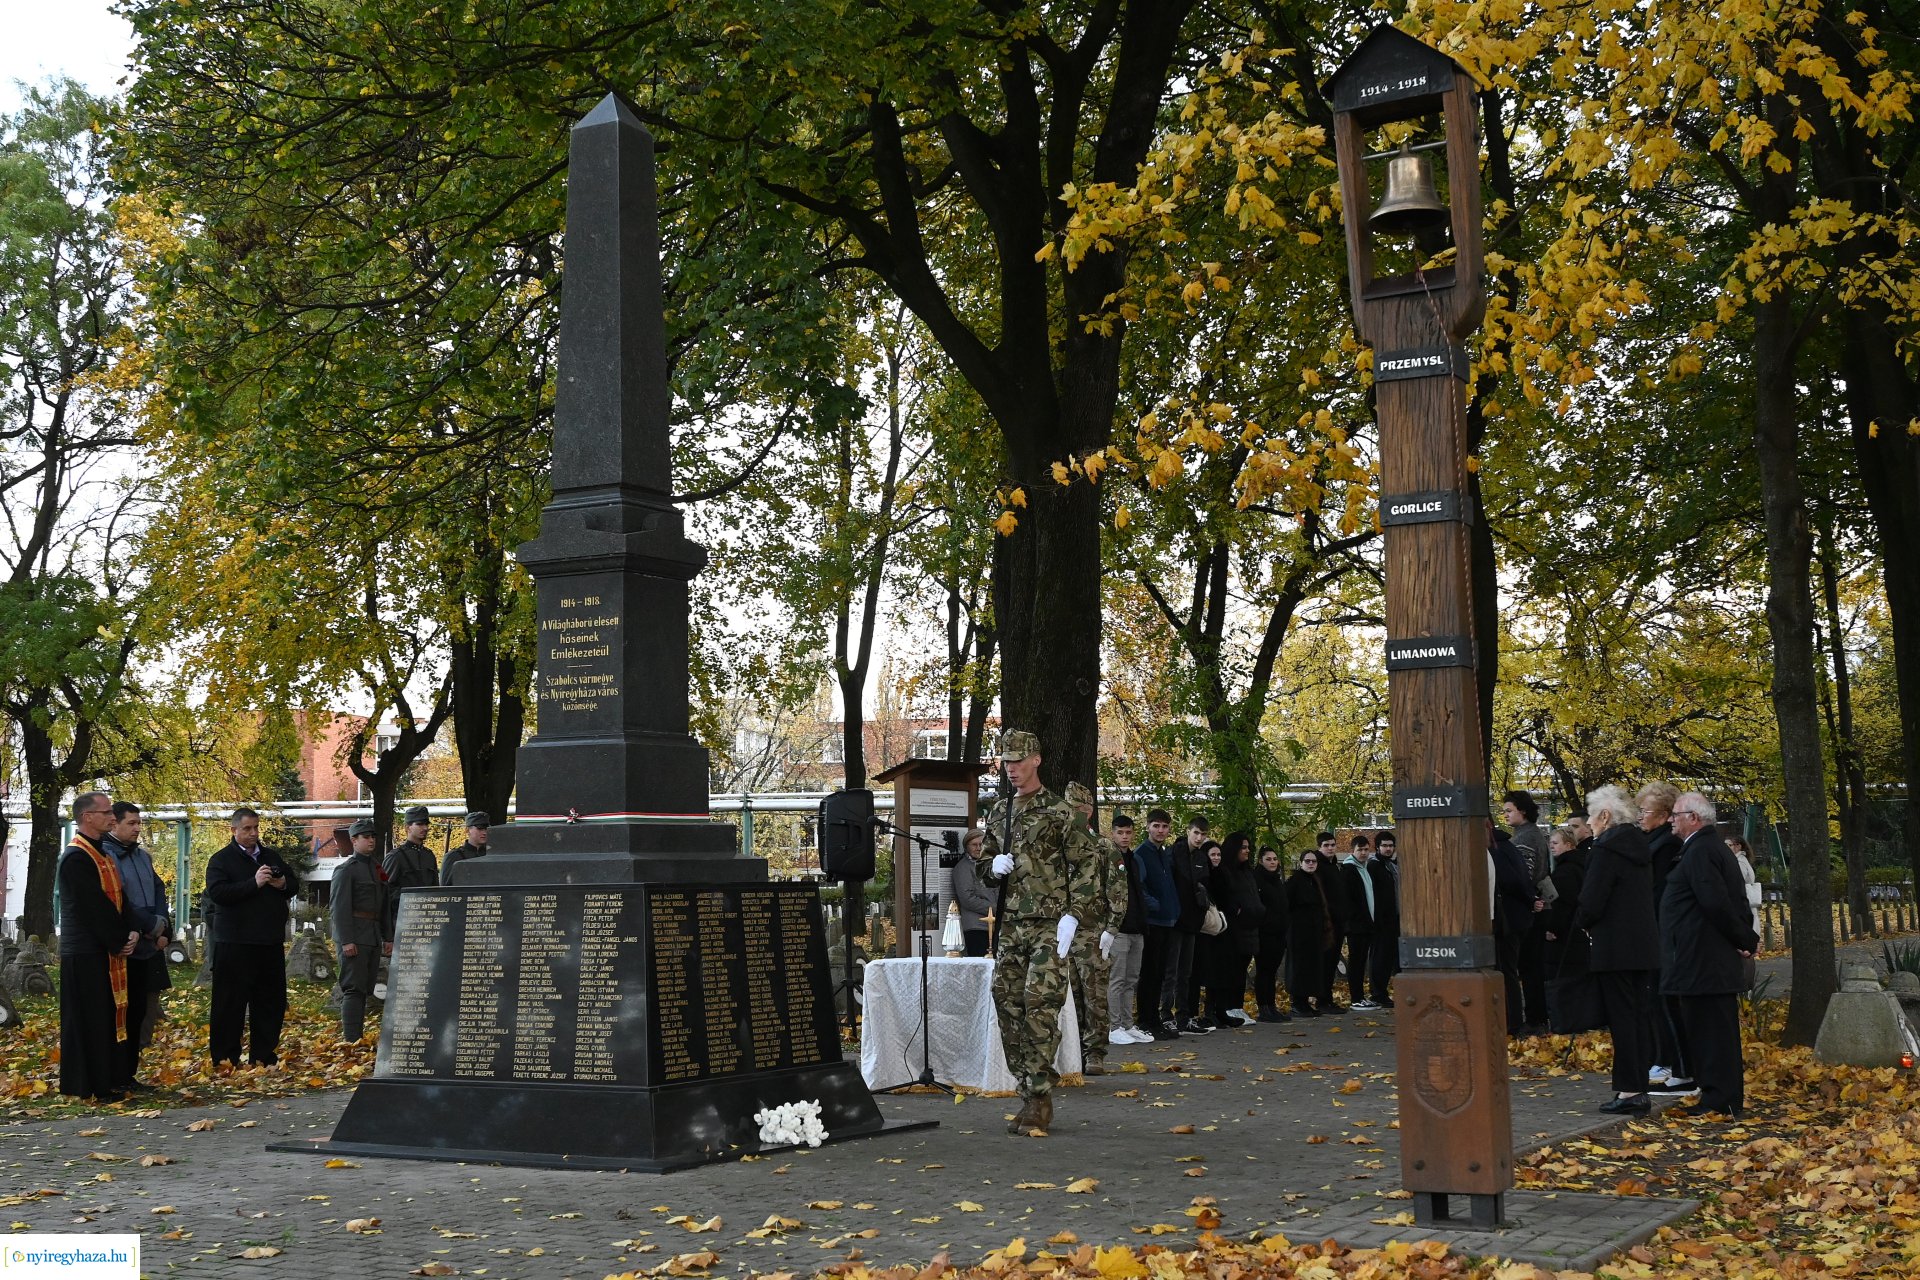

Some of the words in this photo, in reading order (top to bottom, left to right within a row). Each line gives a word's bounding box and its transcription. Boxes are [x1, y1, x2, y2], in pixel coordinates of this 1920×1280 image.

[1360, 85, 1388, 97] 1914
[1398, 76, 1426, 90] 1918
[1380, 356, 1444, 371] PRZEMYSL
[1390, 501, 1442, 515] GORLICE
[560, 598, 576, 608] 1914
[542, 620, 547, 630] A
[548, 617, 592, 632] Világháború
[594, 616, 619, 627] elesett
[560, 631, 599, 644] hőseinek
[551, 645, 609, 660] Emlékezetéül
[1390, 646, 1456, 660] LIMANOWA
[546, 674, 578, 686] Szabolcs
[579, 672, 614, 686] vármegye
[541, 690, 549, 699] és
[551, 686, 597, 702] Nyíregyháza
[598, 686, 618, 696] város
[1406, 795, 1452, 808] ERDÉLY
[1416, 948, 1456, 958] UZSOK
